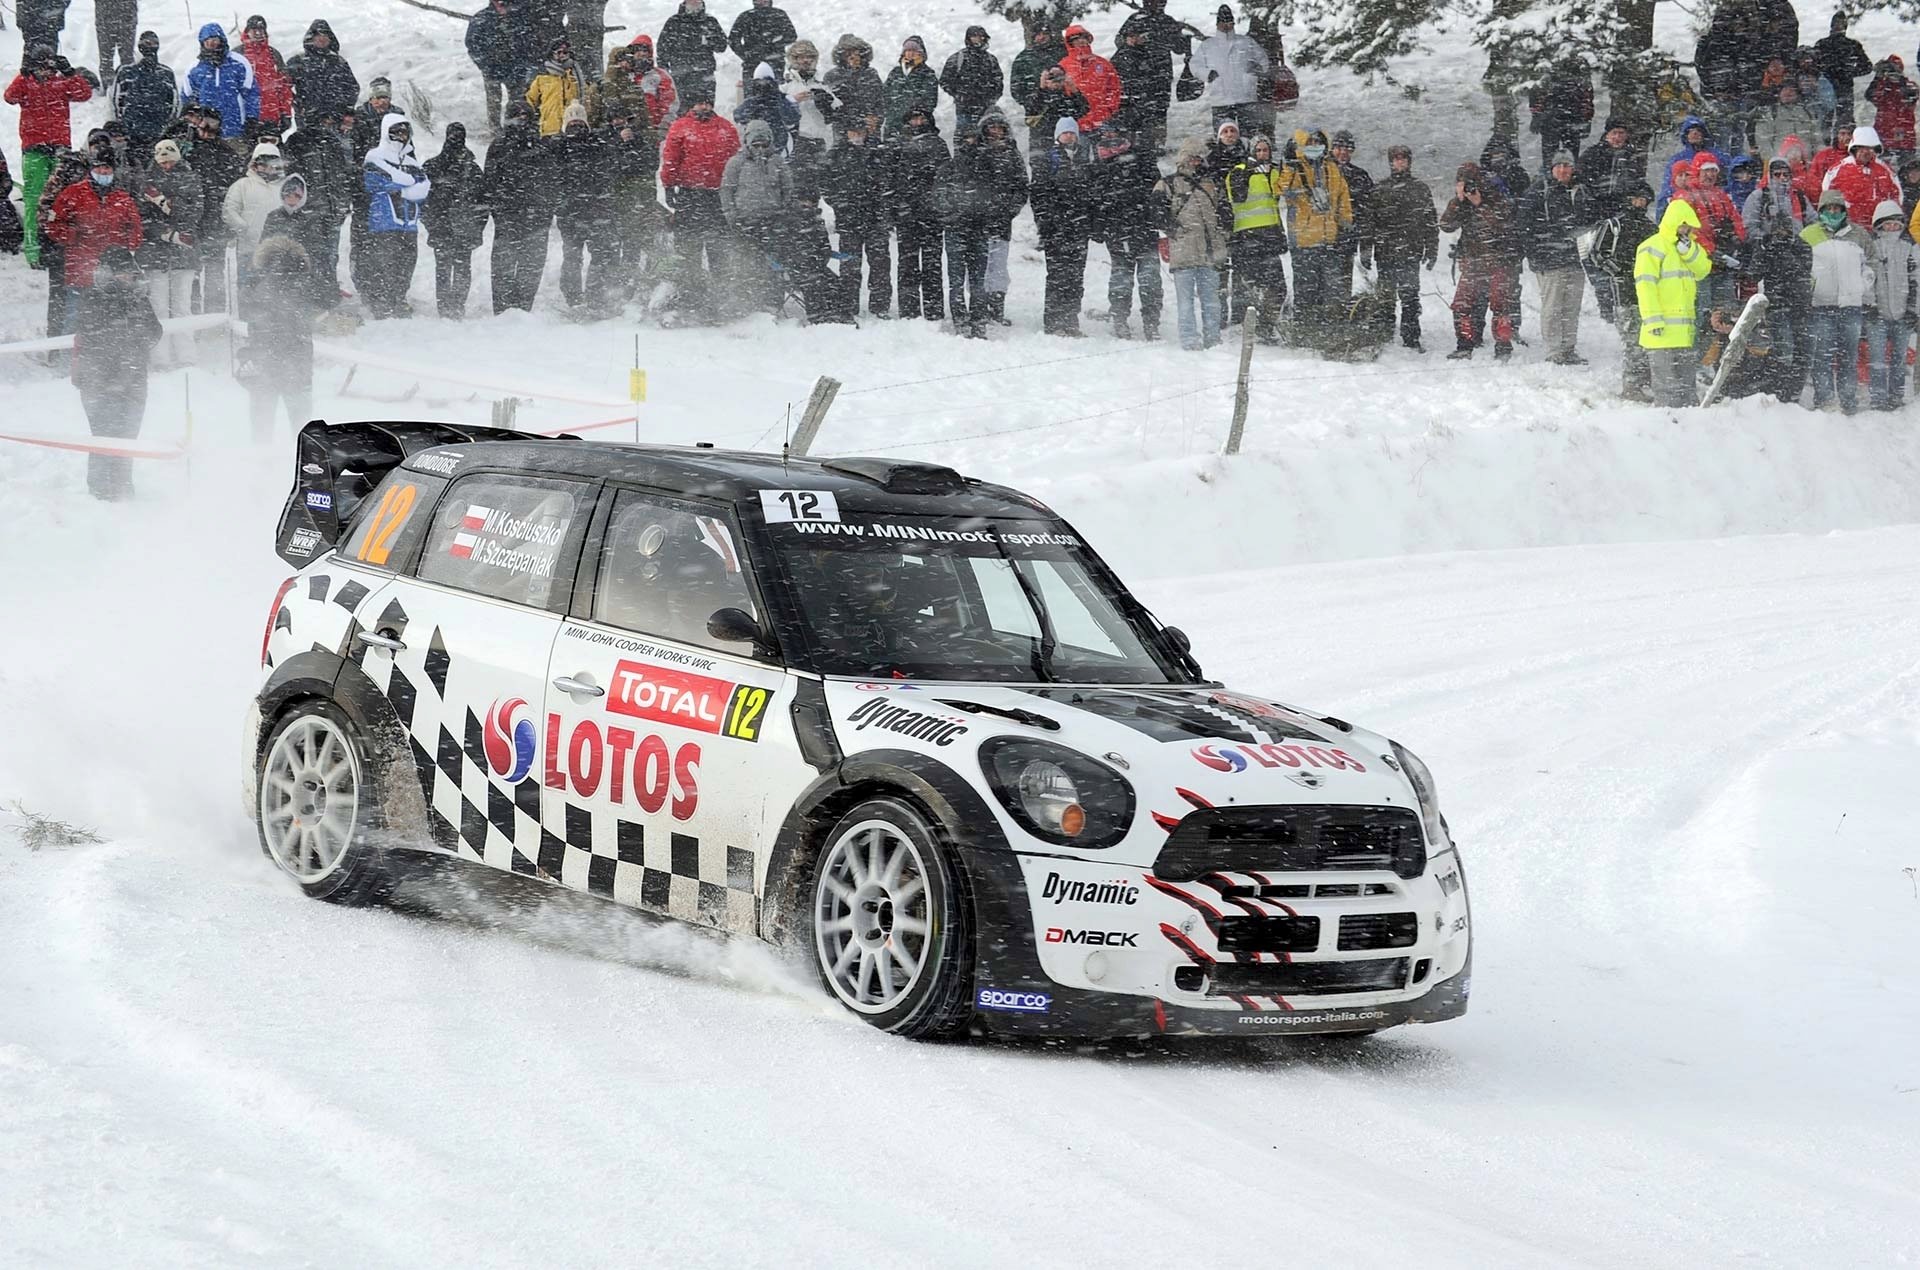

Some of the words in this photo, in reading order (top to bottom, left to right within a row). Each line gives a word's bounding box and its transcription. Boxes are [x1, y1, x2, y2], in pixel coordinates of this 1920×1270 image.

[307, 492, 332, 506] sparco
[779, 492, 822, 519] 12
[357, 484, 416, 565] 12
[482, 508, 561, 546] M.Kosciuszko
[470, 537, 555, 578] M.Szczepaniak
[564, 626, 587, 640] MINI
[586, 633, 616, 646] JOHN
[614, 639, 656, 656] COOPER
[654, 648, 692, 665] WORKS
[691, 657, 717, 671] WRC
[728, 686, 766, 739] 12
[847, 696, 968, 746] Dynamic
[545, 712, 701, 821] LOTOS
[1236, 743, 1366, 773] LOTOS
[1042, 871, 1139, 905] Dynamic
[980, 990, 1046, 1007] sparco
[1238, 1010, 1384, 1026] motorsport-italia.com
